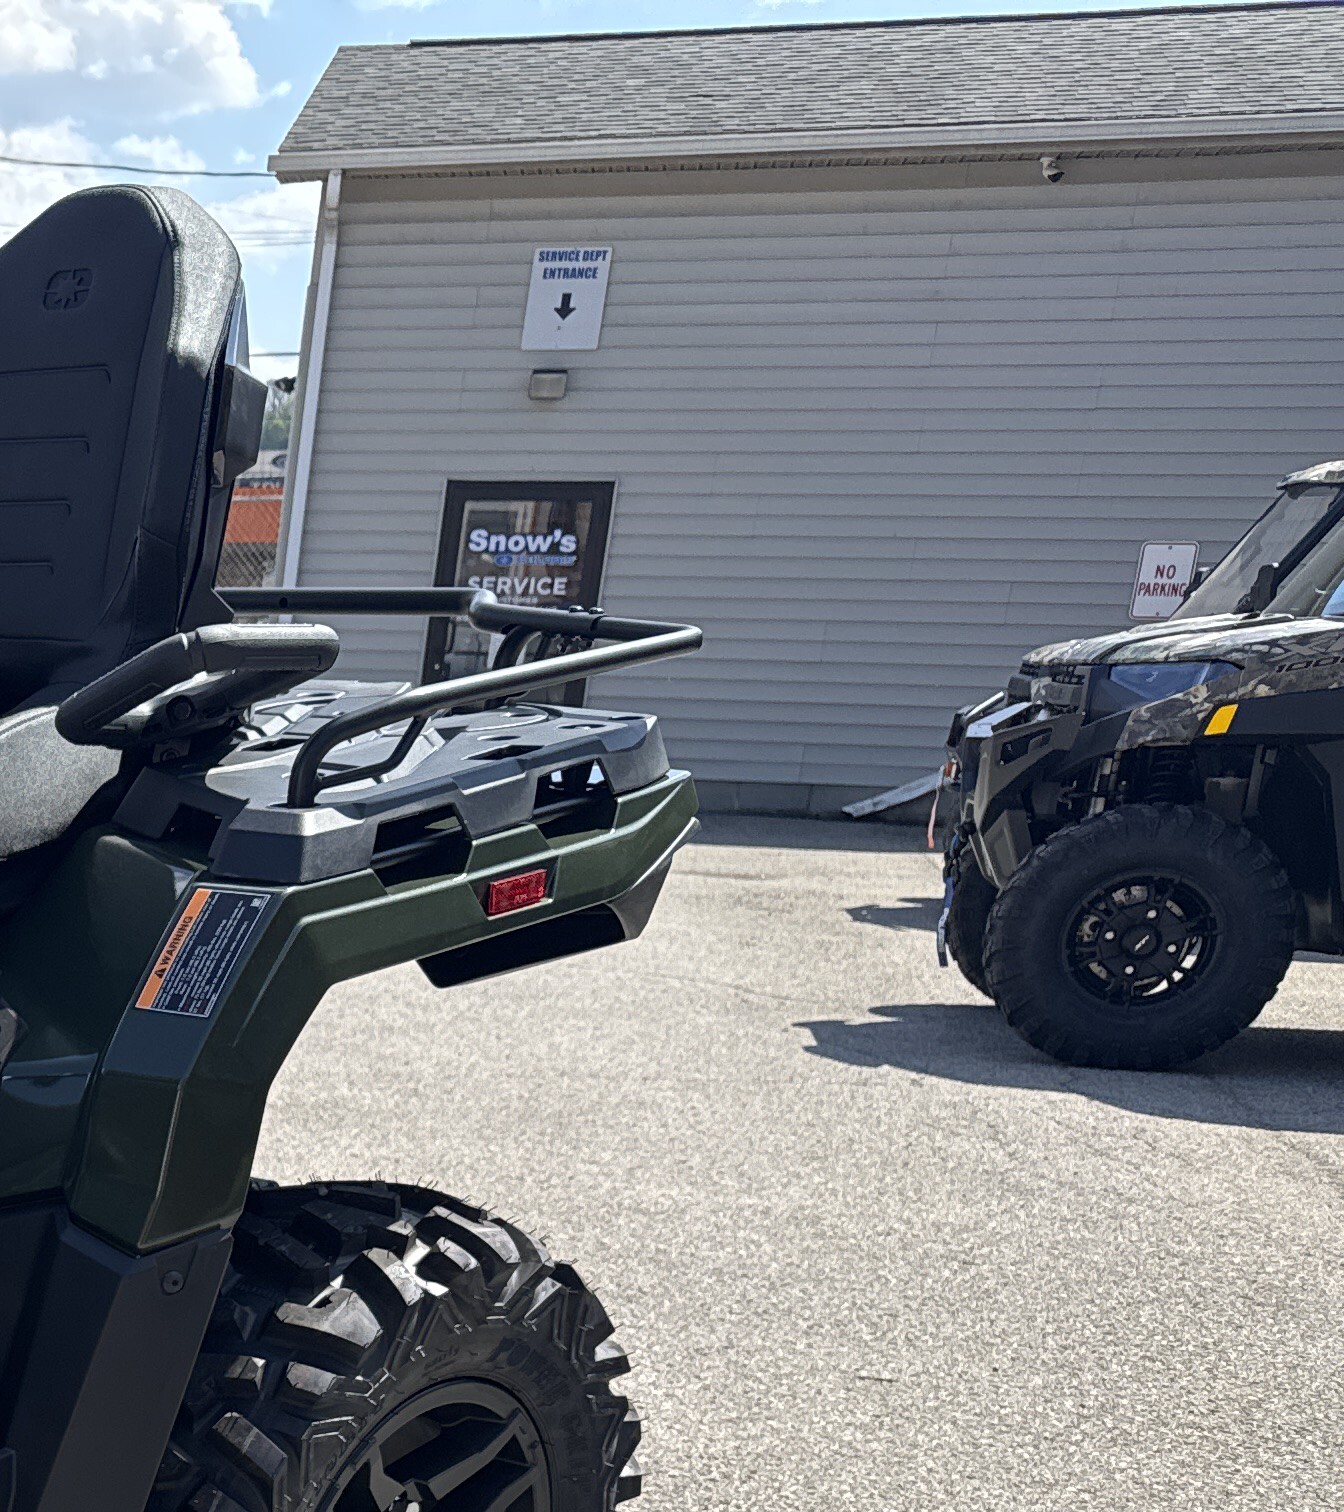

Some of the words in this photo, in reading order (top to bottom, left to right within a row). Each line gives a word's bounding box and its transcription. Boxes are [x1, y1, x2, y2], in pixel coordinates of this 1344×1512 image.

[538, 250, 581, 262] SERVICE
[582, 250, 608, 262] DEPT
[542, 266, 598, 279] ENTRANCE
[468, 528, 577, 553] Snow's
[1154, 564, 1177, 579] NO
[468, 575, 568, 596] SERVICE
[160, 915, 193, 967] WARNING
